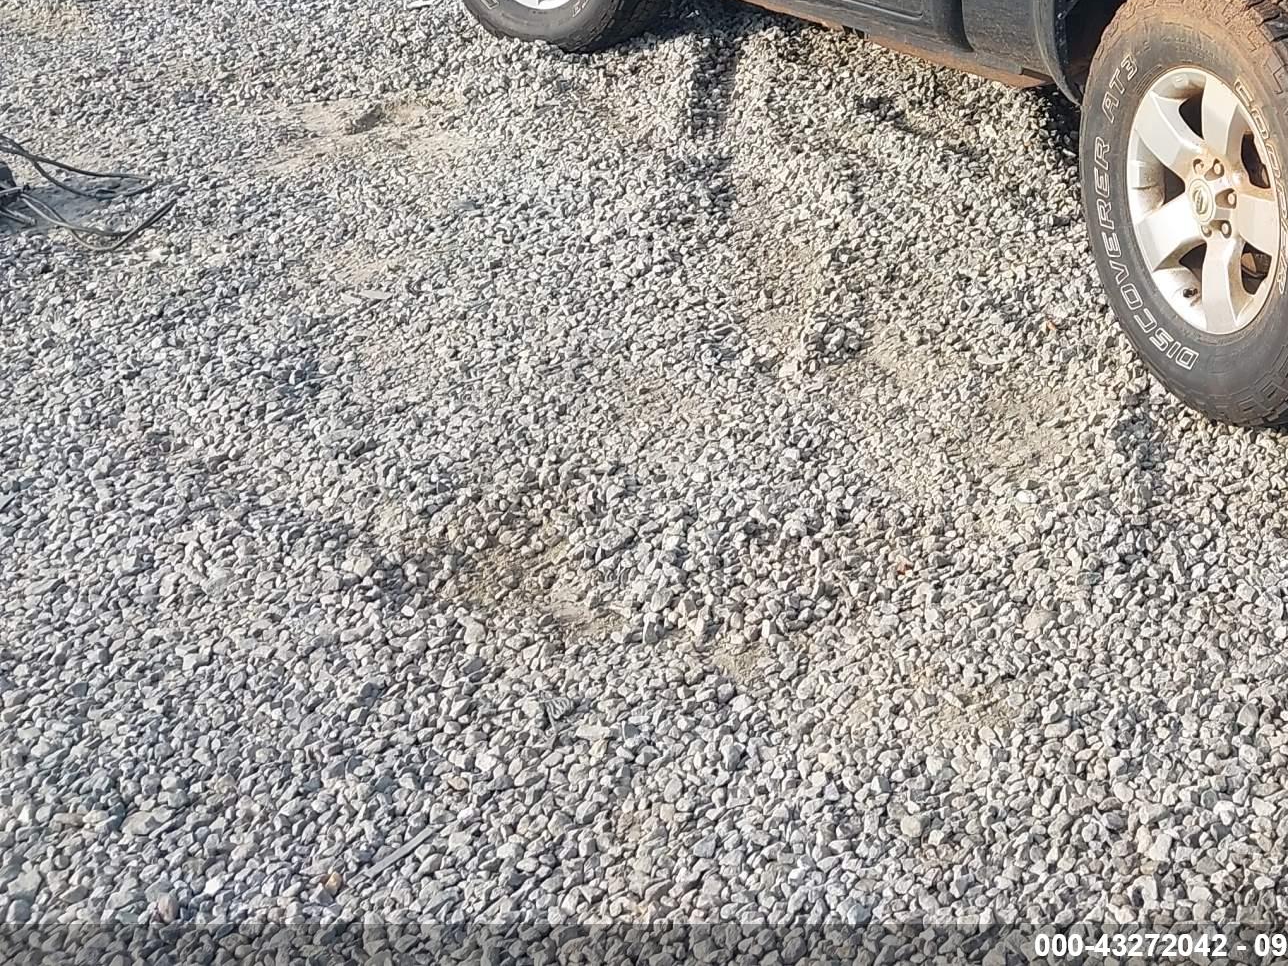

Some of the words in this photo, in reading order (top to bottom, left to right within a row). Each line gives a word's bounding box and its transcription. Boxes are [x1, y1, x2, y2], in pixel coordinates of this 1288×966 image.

[1101, 54, 1139, 125] AT3
[1234, 77, 1288, 295] COOPER
[1094, 135, 1201, 371] DISCOVERER
